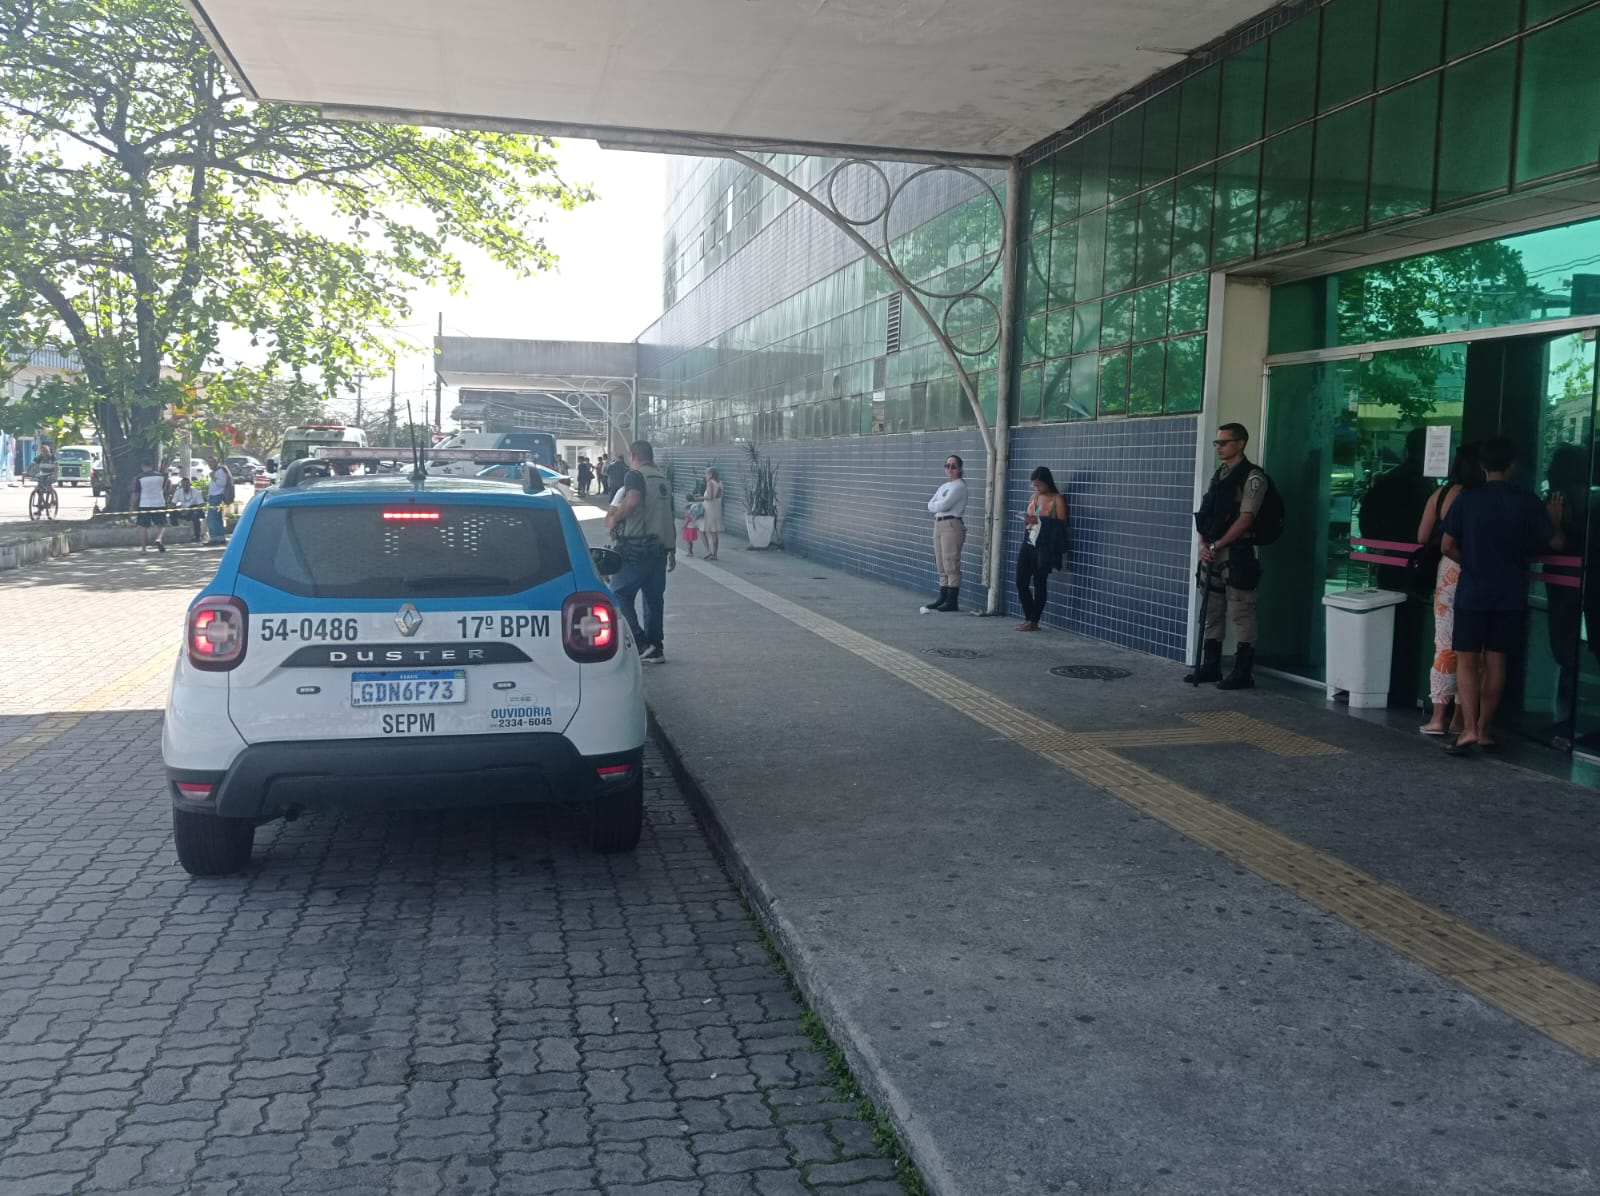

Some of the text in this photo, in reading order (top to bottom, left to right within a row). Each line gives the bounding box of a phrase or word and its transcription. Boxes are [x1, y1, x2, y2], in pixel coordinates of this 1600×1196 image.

[261, 618, 358, 641] 54-0486
[457, 615, 550, 638] 17º BPM
[329, 649, 484, 661] DUSTER
[362, 681, 454, 702] GDN6F73
[491, 706, 552, 719] OUVIDORIA
[499, 717, 552, 728] 2334-6045
[382, 713, 435, 734] SEPM
